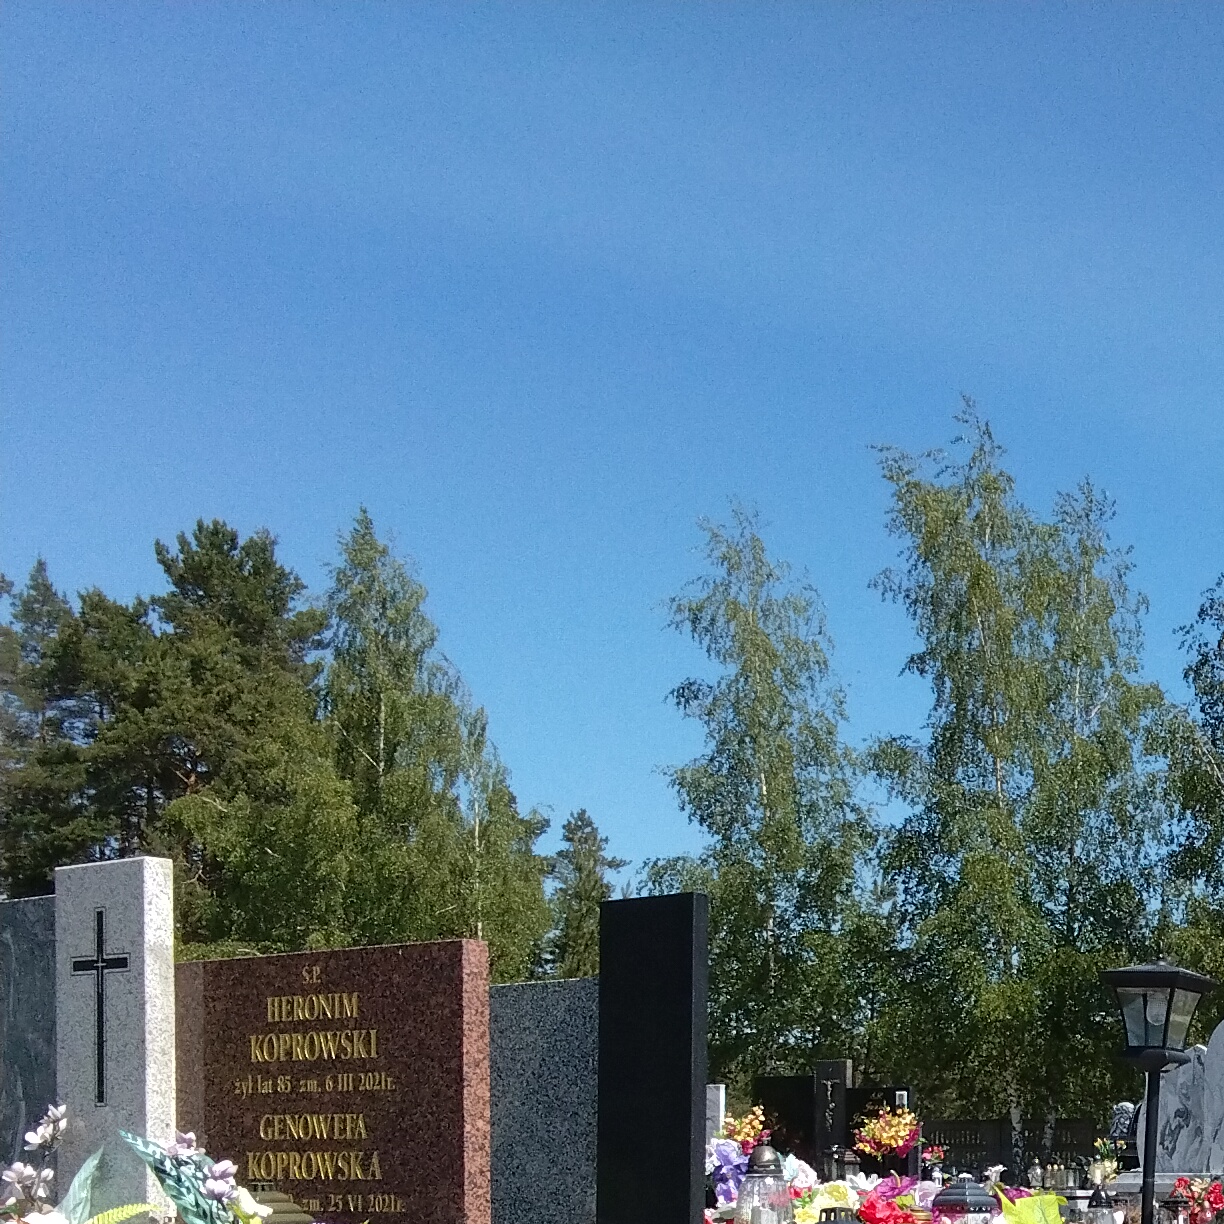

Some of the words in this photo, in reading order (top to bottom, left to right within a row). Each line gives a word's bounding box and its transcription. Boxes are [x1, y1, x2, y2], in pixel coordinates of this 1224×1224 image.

[267, 992, 360, 1022] HERONIM
[250, 1029, 379, 1062] KOPROWSKI
[257, 1074, 273, 1094] lat
[277, 1075, 292, 1094] 85
[299, 1077, 322, 1093] zm.
[325, 1074, 334, 1092] 6
[338, 1073, 354, 1092] III
[259, 1113, 368, 1141] GENOWEFA
[247, 1150, 383, 1180] KOPROWSKA
[328, 1194, 343, 1212] 25
[348, 1194, 362, 1212] VI
